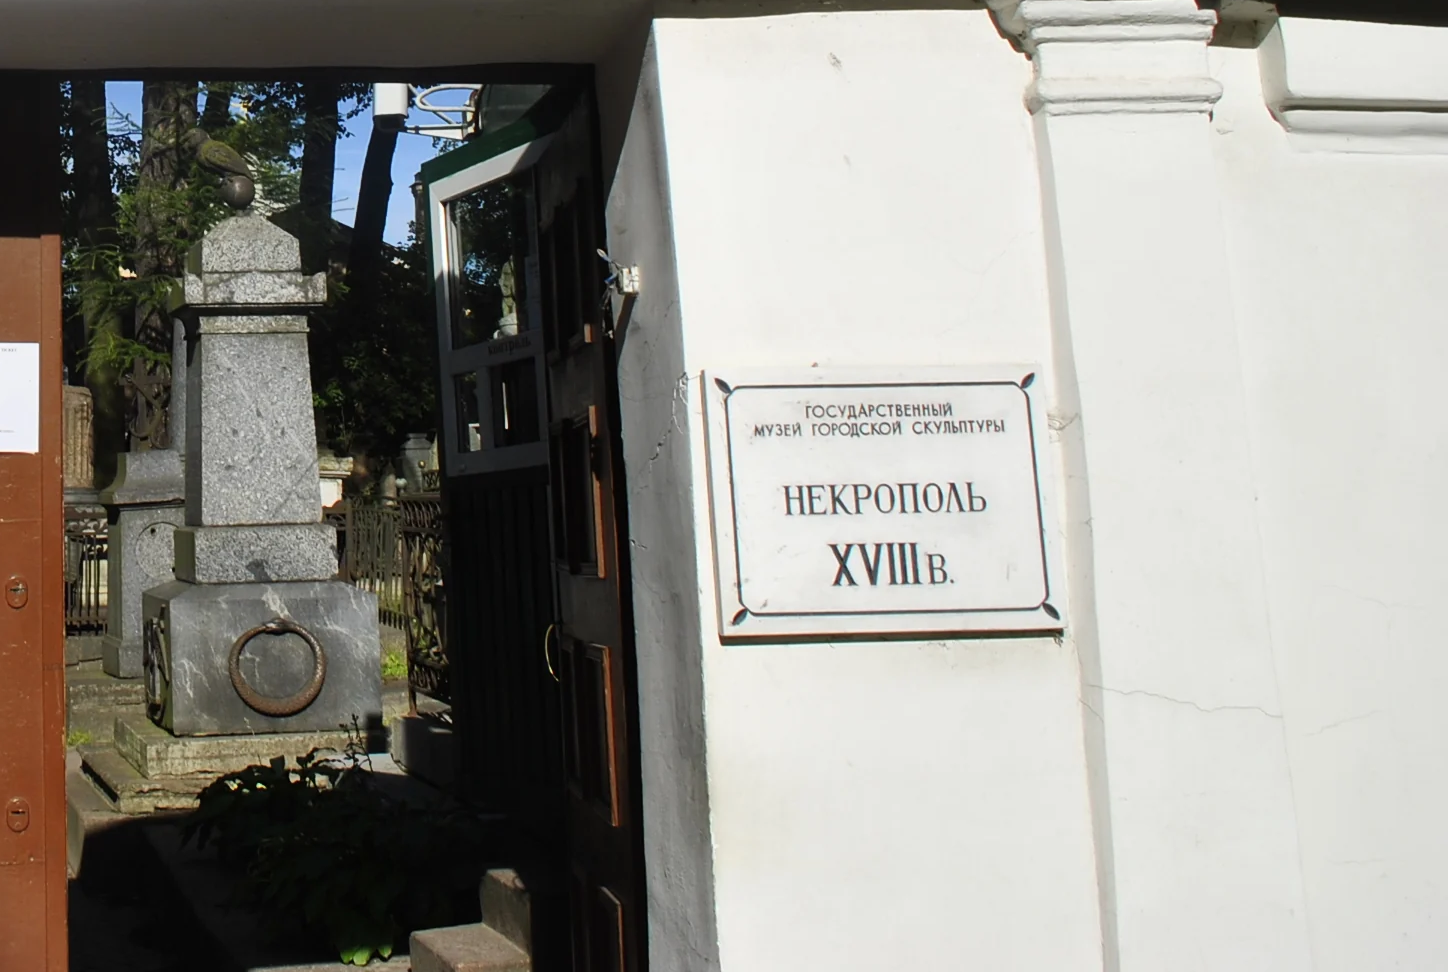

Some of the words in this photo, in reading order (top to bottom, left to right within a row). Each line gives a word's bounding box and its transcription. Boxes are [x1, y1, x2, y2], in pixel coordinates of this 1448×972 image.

[805, 402, 953, 419] ГОСУДАРСТВЕННЫЙ
[754, 422, 802, 437] МУЗЕЙ
[811, 420, 902, 437] ГОРОДСКОЙ
[912, 419, 1005, 434] СКУЛЬПТУРЫ
[782, 481, 987, 516] НЕКРОПОЛЬ
